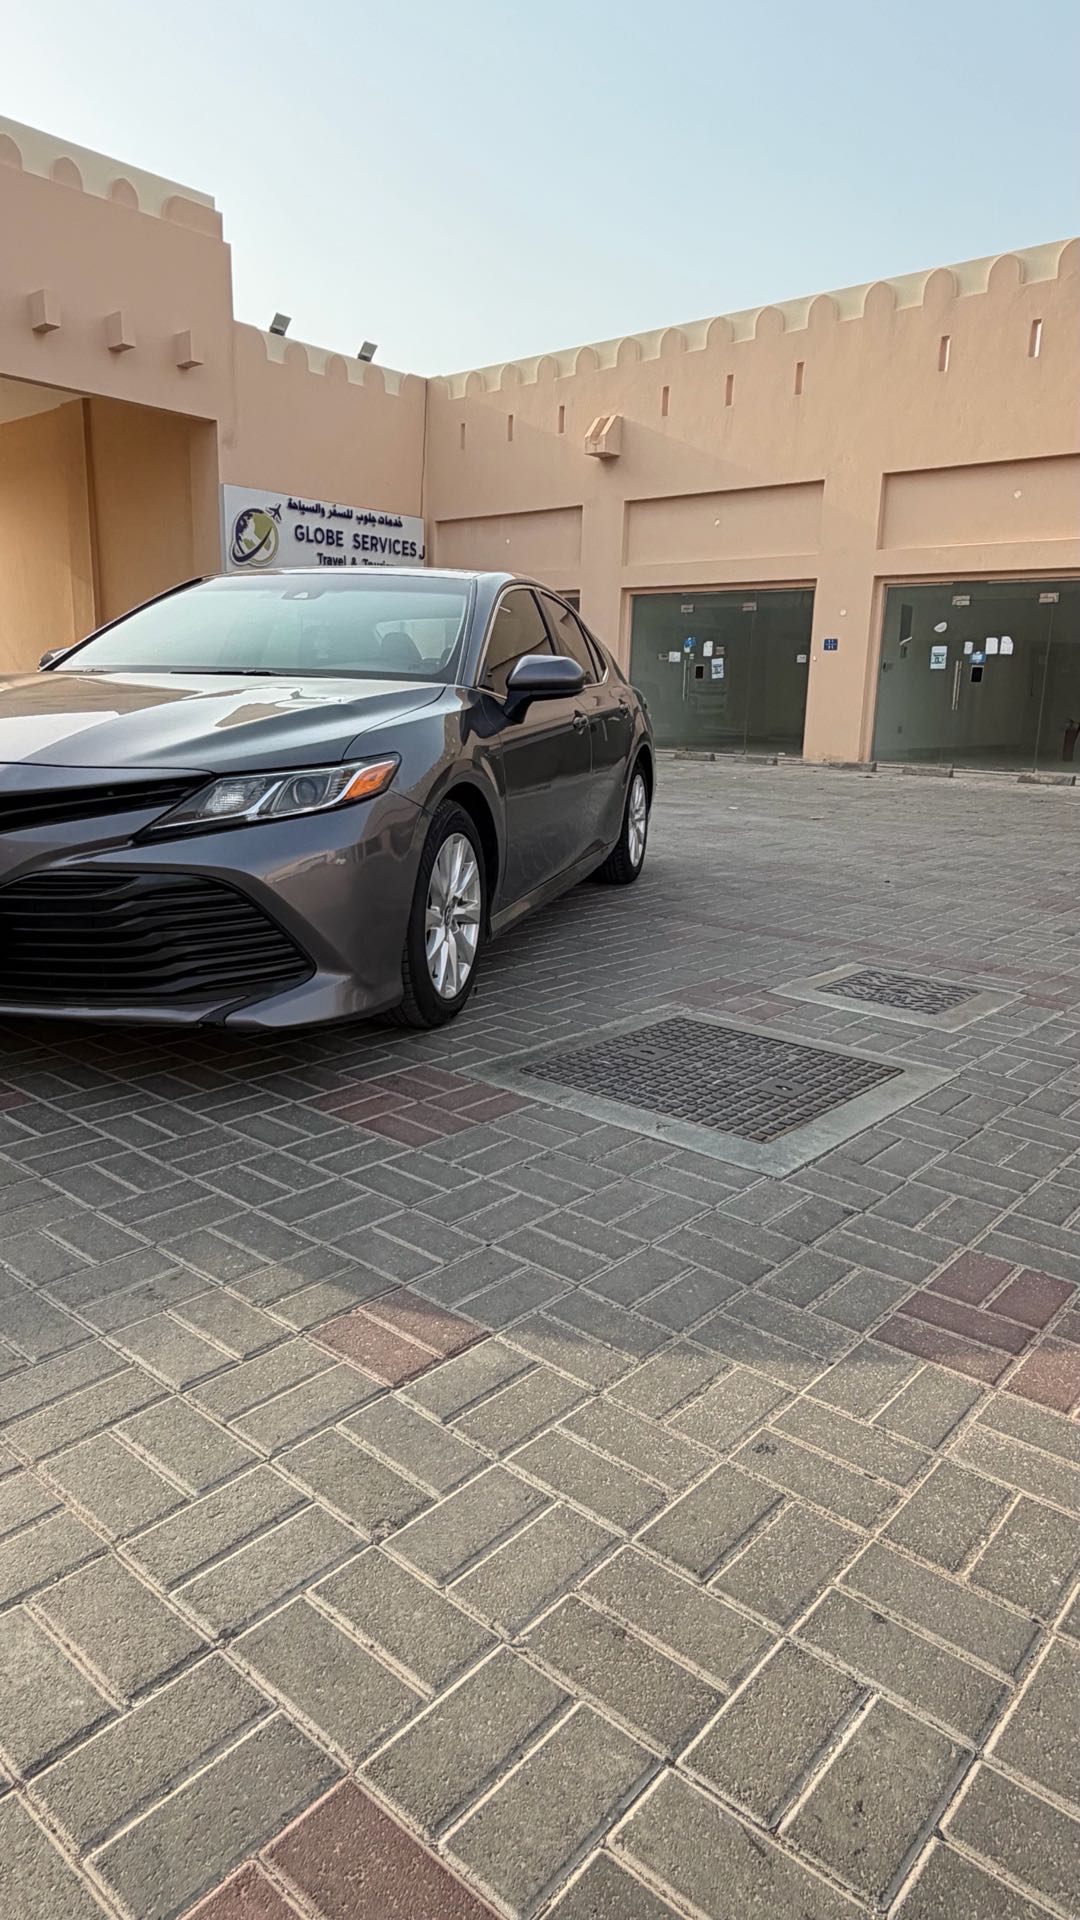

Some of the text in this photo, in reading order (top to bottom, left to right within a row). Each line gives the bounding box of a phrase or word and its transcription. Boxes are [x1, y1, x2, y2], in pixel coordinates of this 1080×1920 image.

[287, 497, 403, 527] خدمات جلوب للسفر والسياحة
[294, 524, 344, 547] GLOBE
[353, 533, 417, 557] SERVICES
[317, 552, 346, 566] Travel
[351, 556, 358, 566] &
